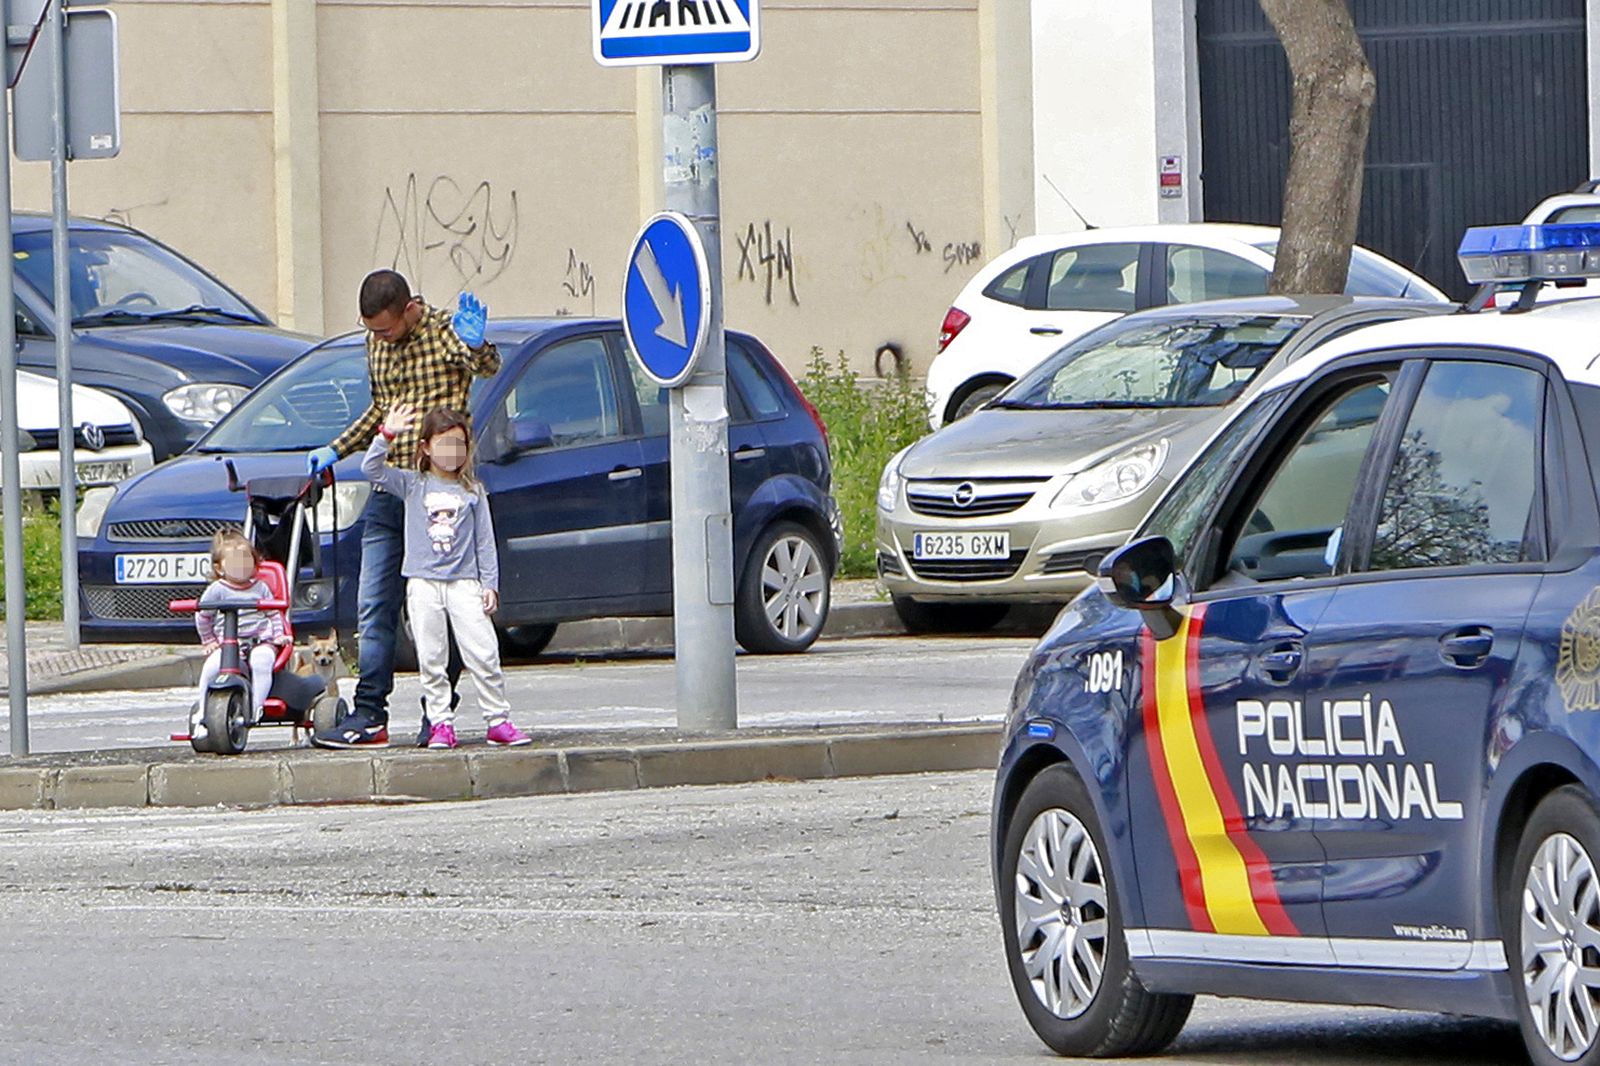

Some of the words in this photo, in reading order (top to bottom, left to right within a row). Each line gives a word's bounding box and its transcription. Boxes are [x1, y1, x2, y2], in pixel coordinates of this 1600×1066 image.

[925, 536, 965, 556] 6235
[971, 535, 1005, 555] GXM
[126, 558, 168, 579] 2720
[1089, 650, 1123, 693] 091
[1236, 692, 1406, 756] POLICÍA
[1242, 762, 1464, 820] NACIONAL
[1392, 923, 1468, 941] www.policia.es
